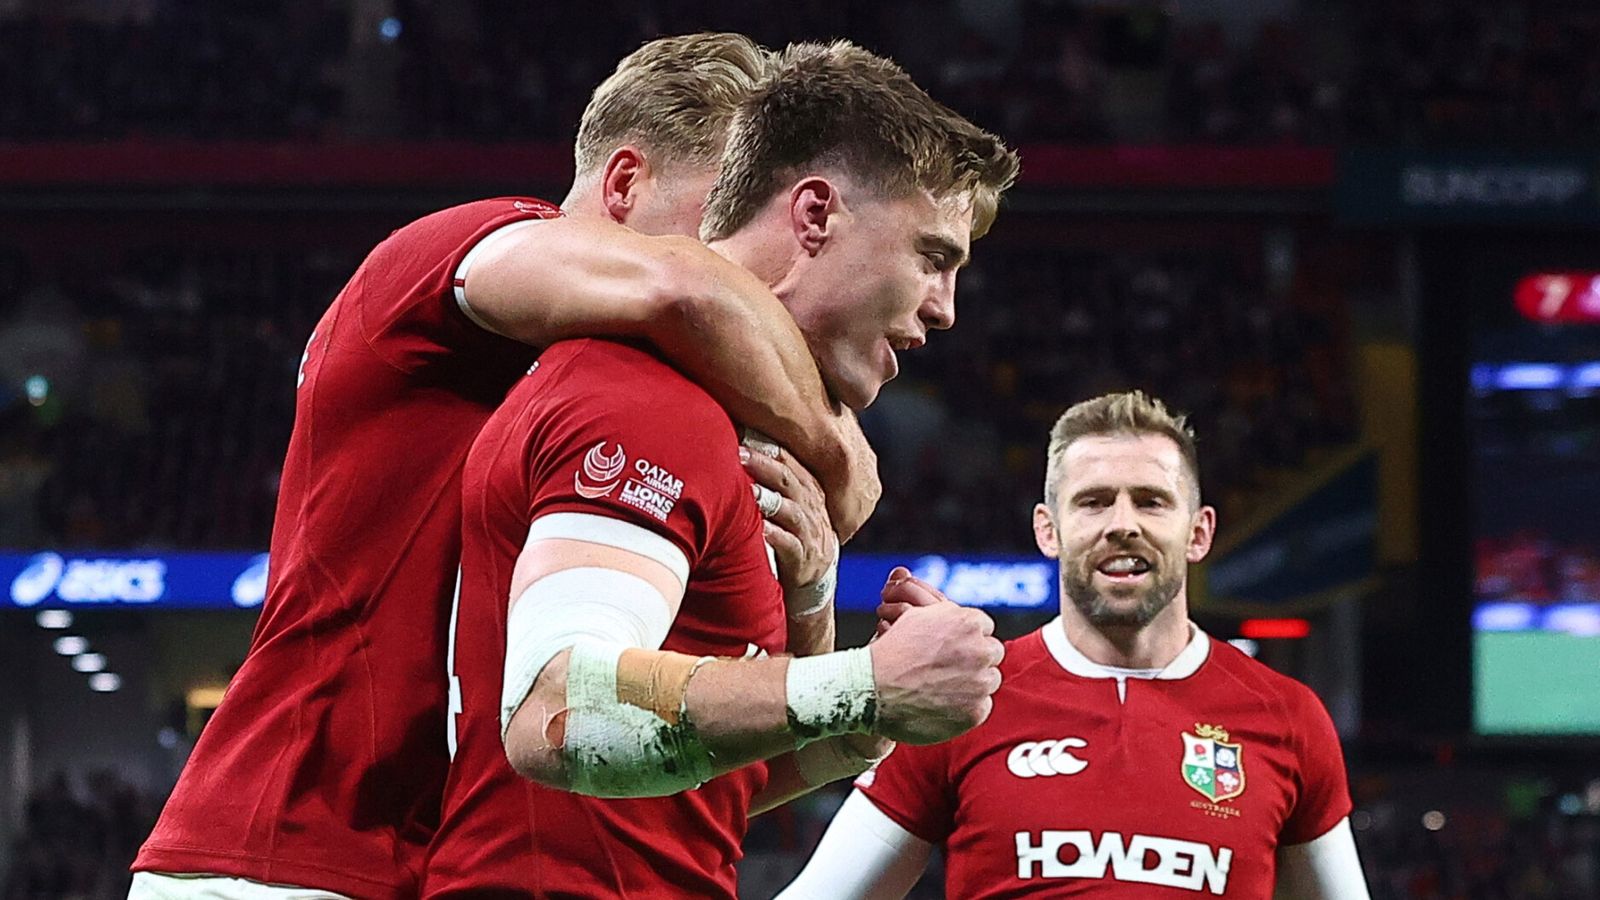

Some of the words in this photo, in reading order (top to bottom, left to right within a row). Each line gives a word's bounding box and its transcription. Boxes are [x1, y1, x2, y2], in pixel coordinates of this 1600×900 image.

[635, 458, 684, 490] QATAR
[643, 475, 682, 499] AIRWAYS
[623, 480, 674, 513] LIONS
[1190, 801, 1241, 817] AUSTRALIA
[1015, 829, 1233, 895] HOWDEN
